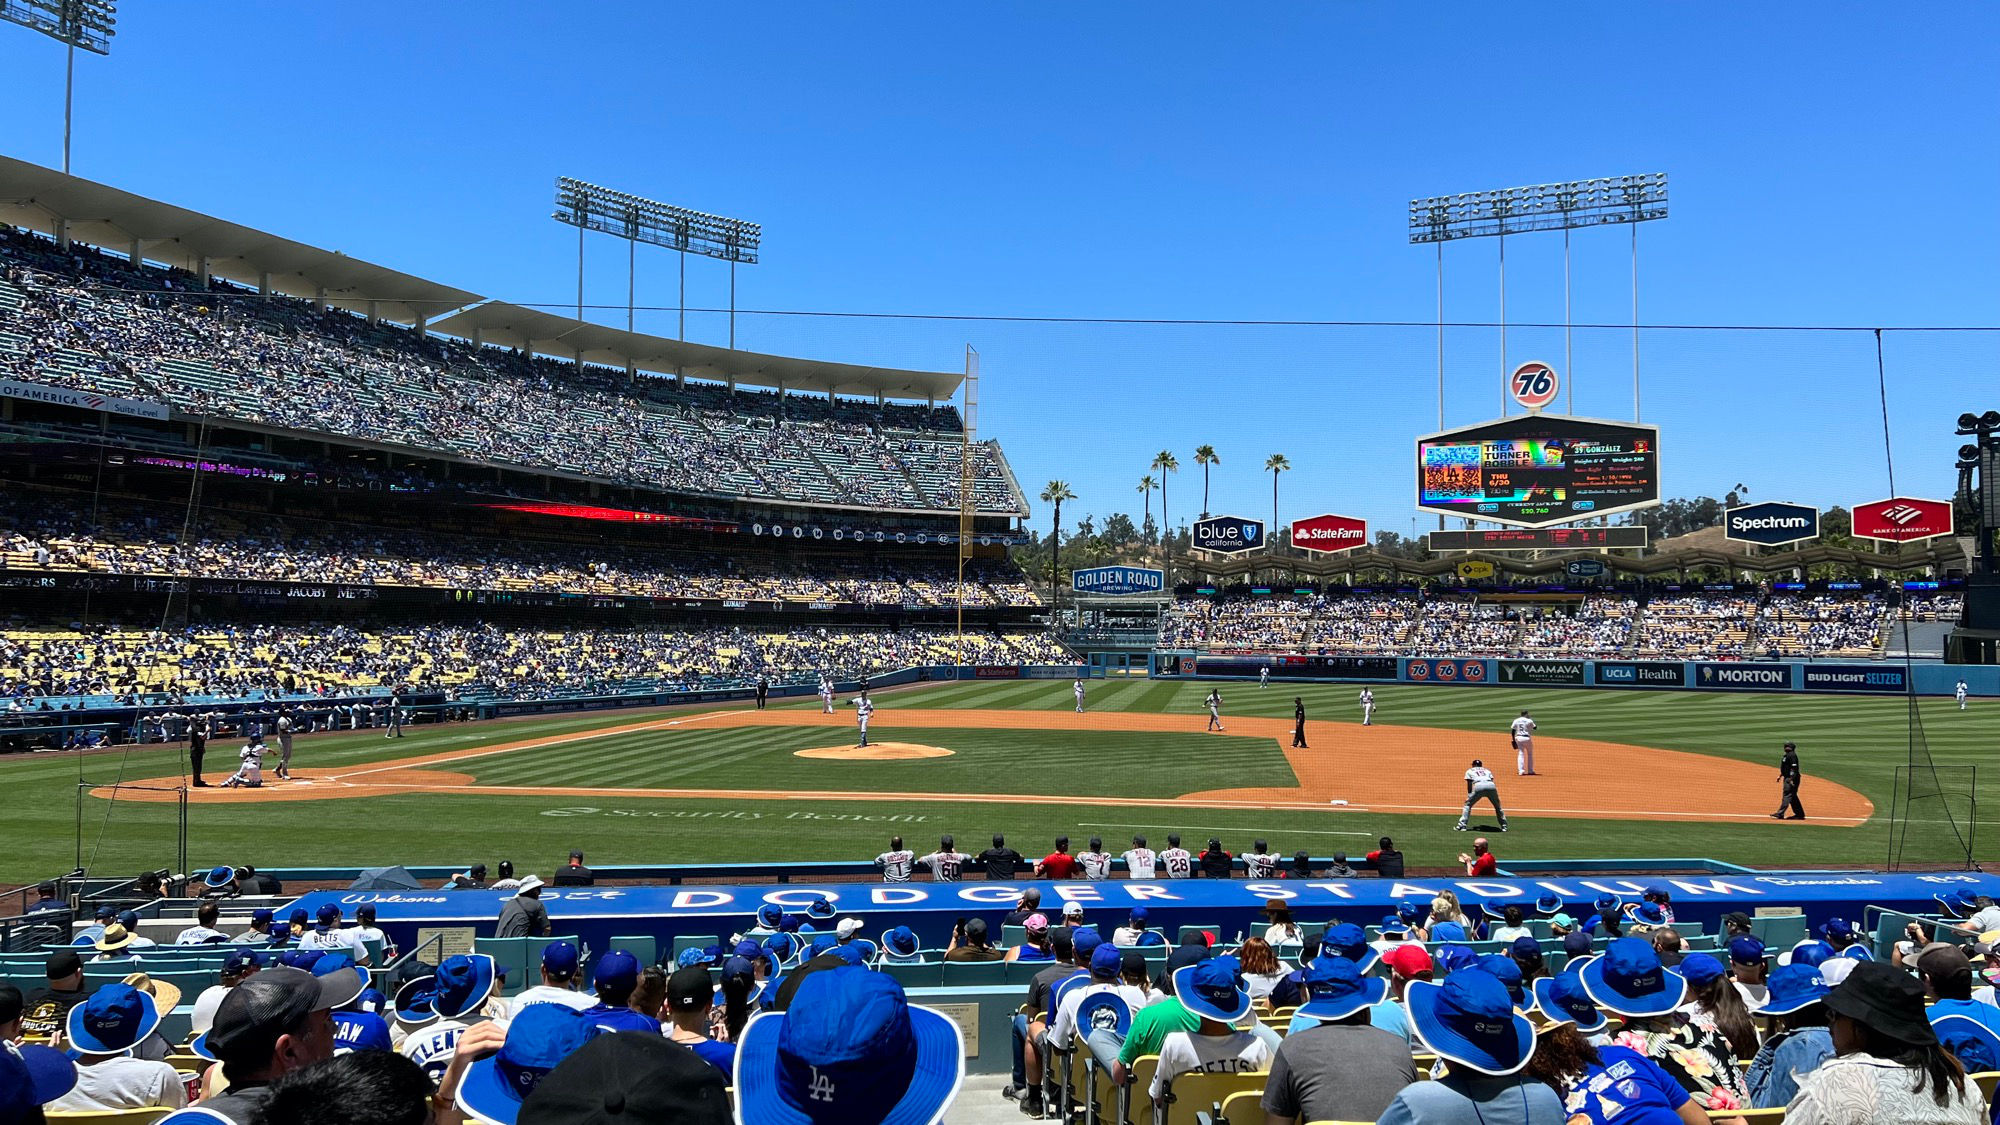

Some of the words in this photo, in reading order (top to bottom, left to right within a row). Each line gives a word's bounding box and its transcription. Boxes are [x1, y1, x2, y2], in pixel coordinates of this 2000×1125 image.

[1517, 369, 1552, 397] 76
[3, 386, 20, 396] OF
[23, 387, 78, 405] AMERICA
[114, 403, 135, 414] Suite
[137, 407, 158, 418] Level
[1484, 443, 1514, 452] TREA
[1484, 451, 1530, 460] TURNER
[1484, 459, 1531, 468] BOBBLE
[267, 470, 286, 482] App
[1732, 516, 1805, 531] Spectrum
[1200, 524, 1238, 539] blue
[1205, 539, 1243, 547] california
[1077, 570, 1122, 588] GOLDEN
[1127, 571, 1158, 588] ROAD
[287, 587, 328, 598] JACOBY
[1182, 662, 1193, 670] 76
[1412, 664, 1427, 676] 76
[1439, 664, 1454, 676] 76
[1466, 664, 1481, 676] 76
[1606, 669, 1632, 678] UCLA
[1638, 668, 1677, 680] Health
[1718, 670, 1782, 683] MORTON
[1807, 673, 1831, 681] BUD
[1832, 674, 1865, 682] LIGHT
[1866, 672, 1902, 684] SELTZER
[604, 808, 777, 821] Security
[786, 810, 930, 823] Benefit
[1136, 856, 1152, 868] 12
[1170, 858, 1188, 873] 28
[341, 893, 448, 904] Welcome
[671, 885, 1185, 908] DODGER
[1244, 880, 1765, 900] STADIUM
[313, 933, 338, 944] BETTS
[808, 1064, 835, 1102] LA
